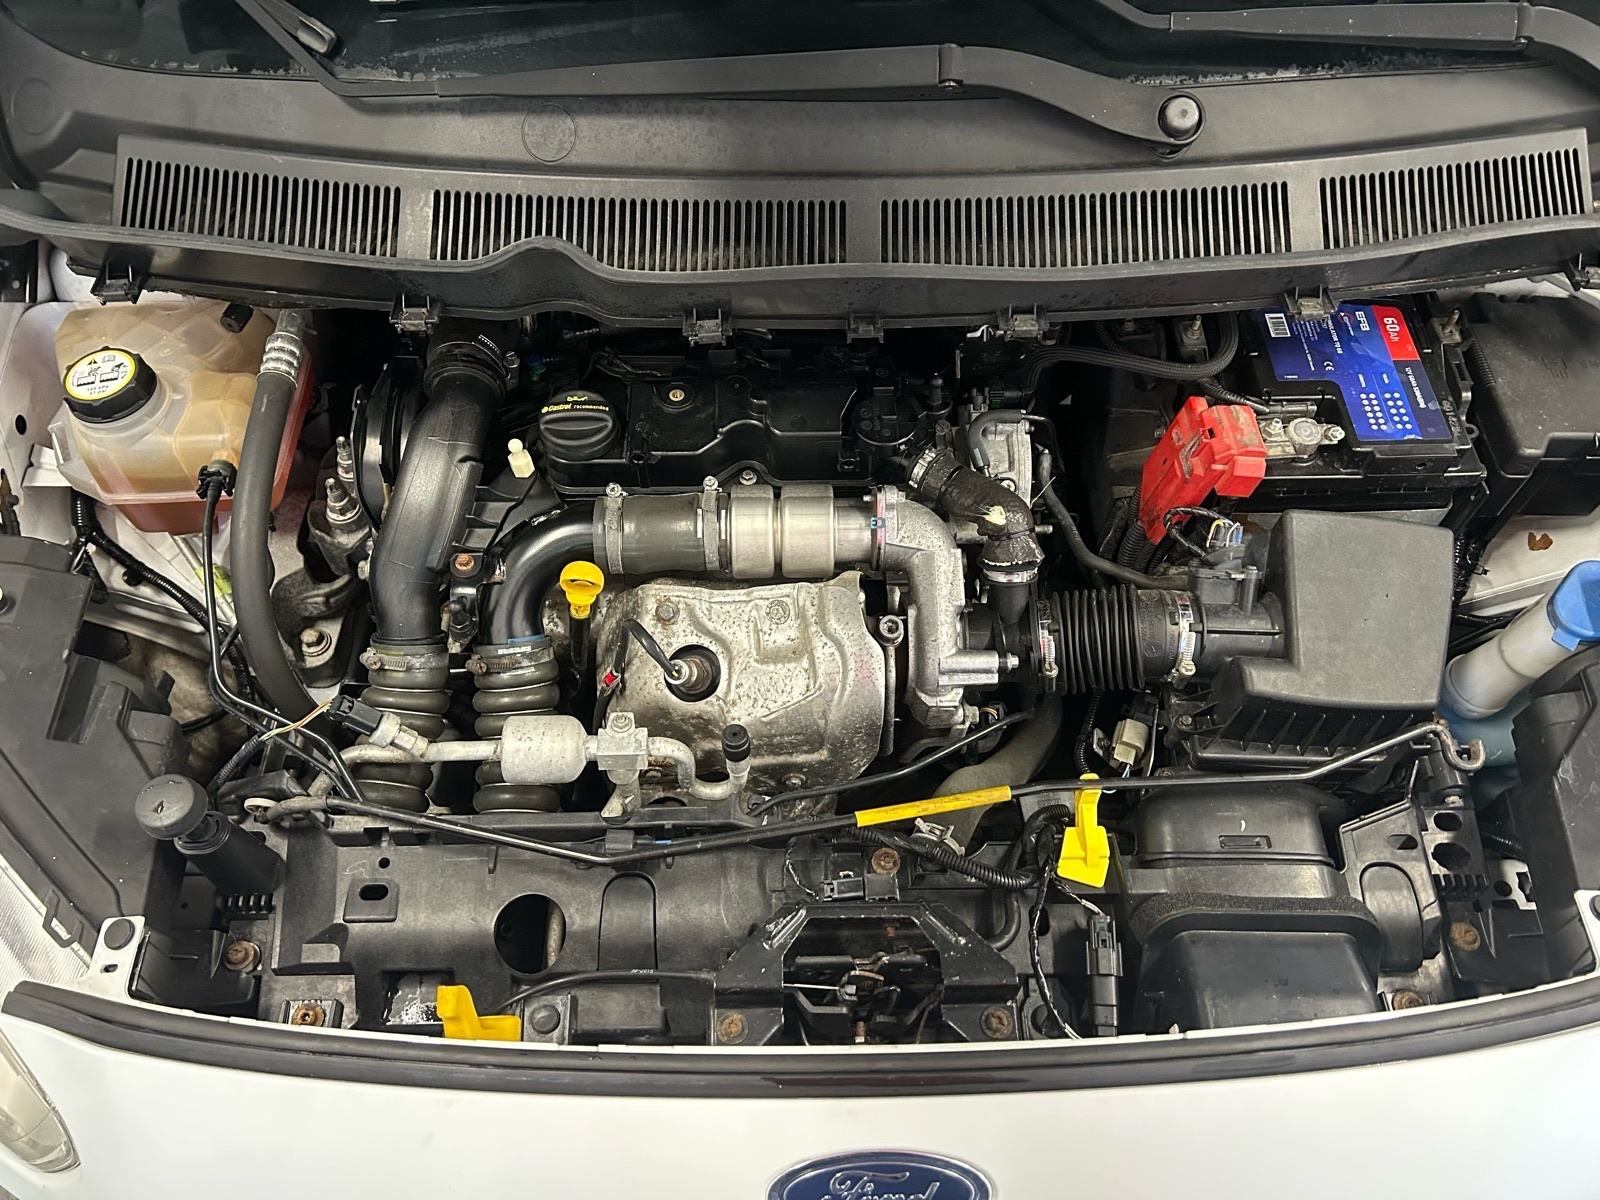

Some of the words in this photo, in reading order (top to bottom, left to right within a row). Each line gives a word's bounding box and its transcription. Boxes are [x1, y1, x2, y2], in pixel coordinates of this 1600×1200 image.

[1355, 311, 1370, 331] EFB
[1383, 317, 1401, 342] 60Ah
[548, 403, 572, 411] Castrol
